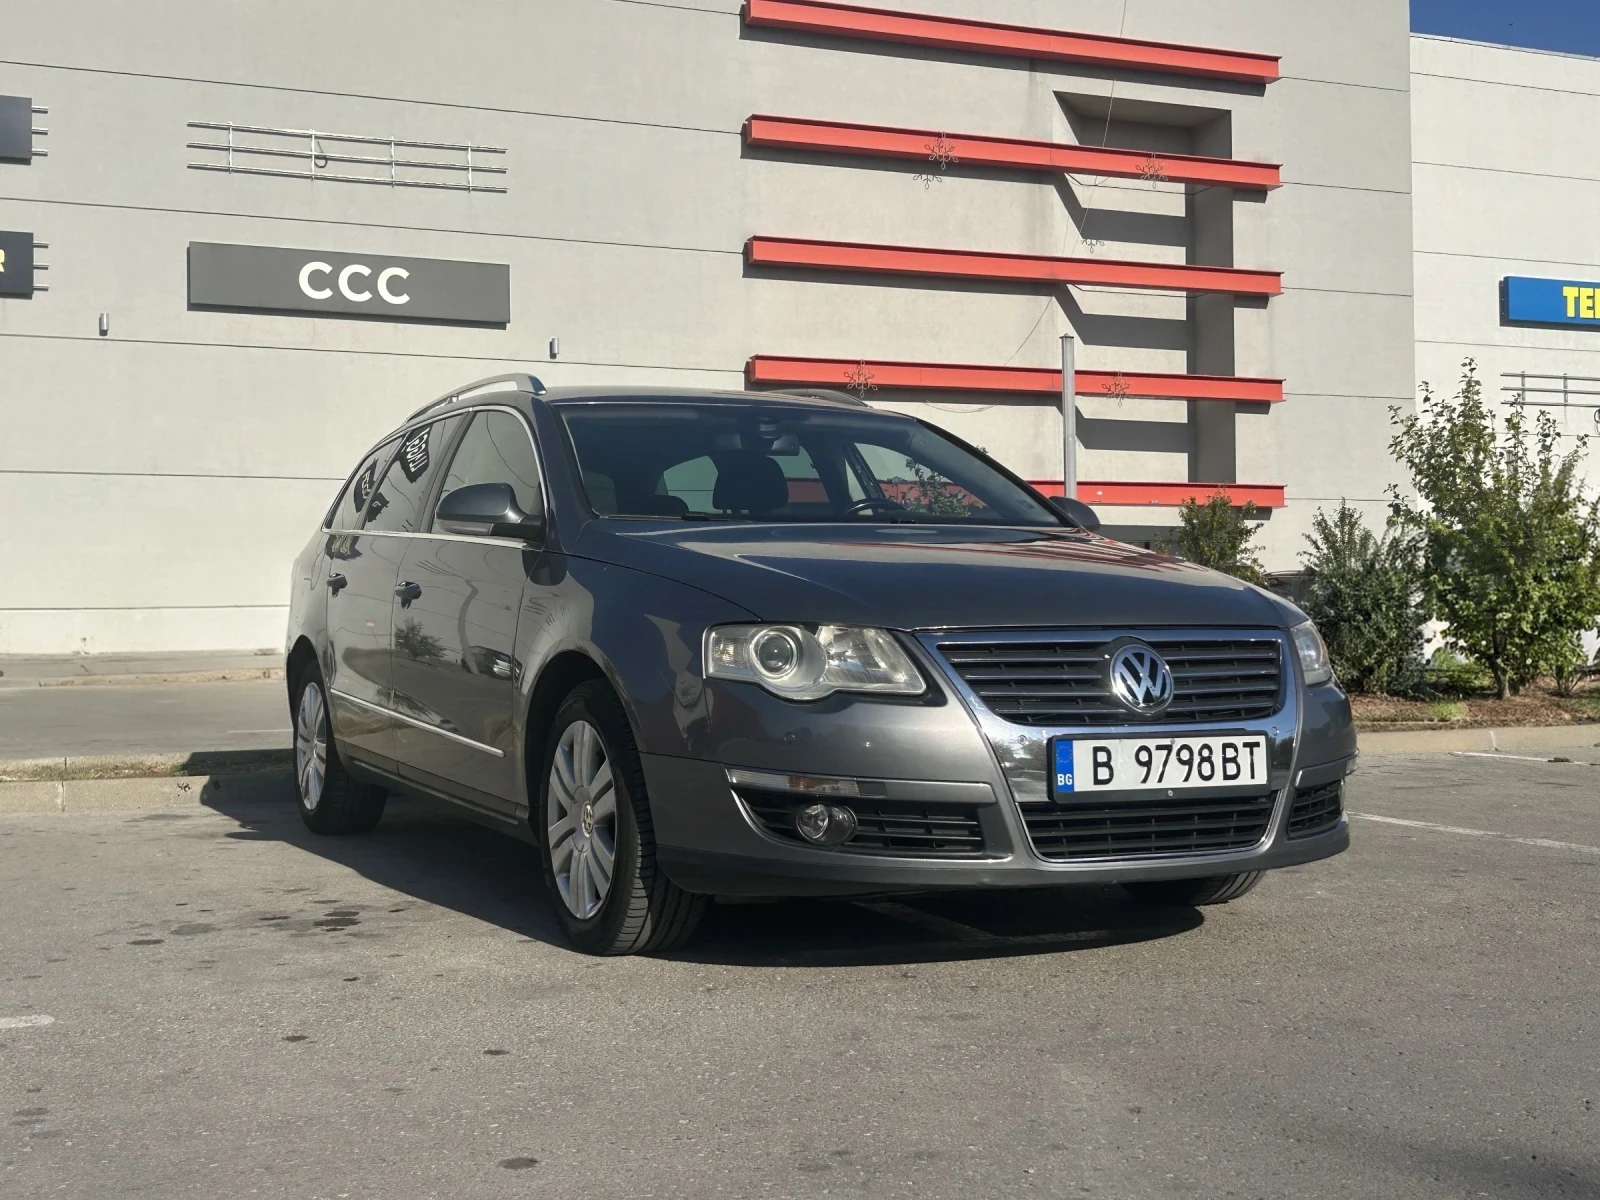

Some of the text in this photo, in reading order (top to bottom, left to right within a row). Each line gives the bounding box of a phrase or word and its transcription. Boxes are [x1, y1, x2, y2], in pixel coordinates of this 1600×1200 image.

[298, 261, 411, 305] CCC
[1112, 646, 1171, 709] VW
[1057, 773, 1073, 786] BG
